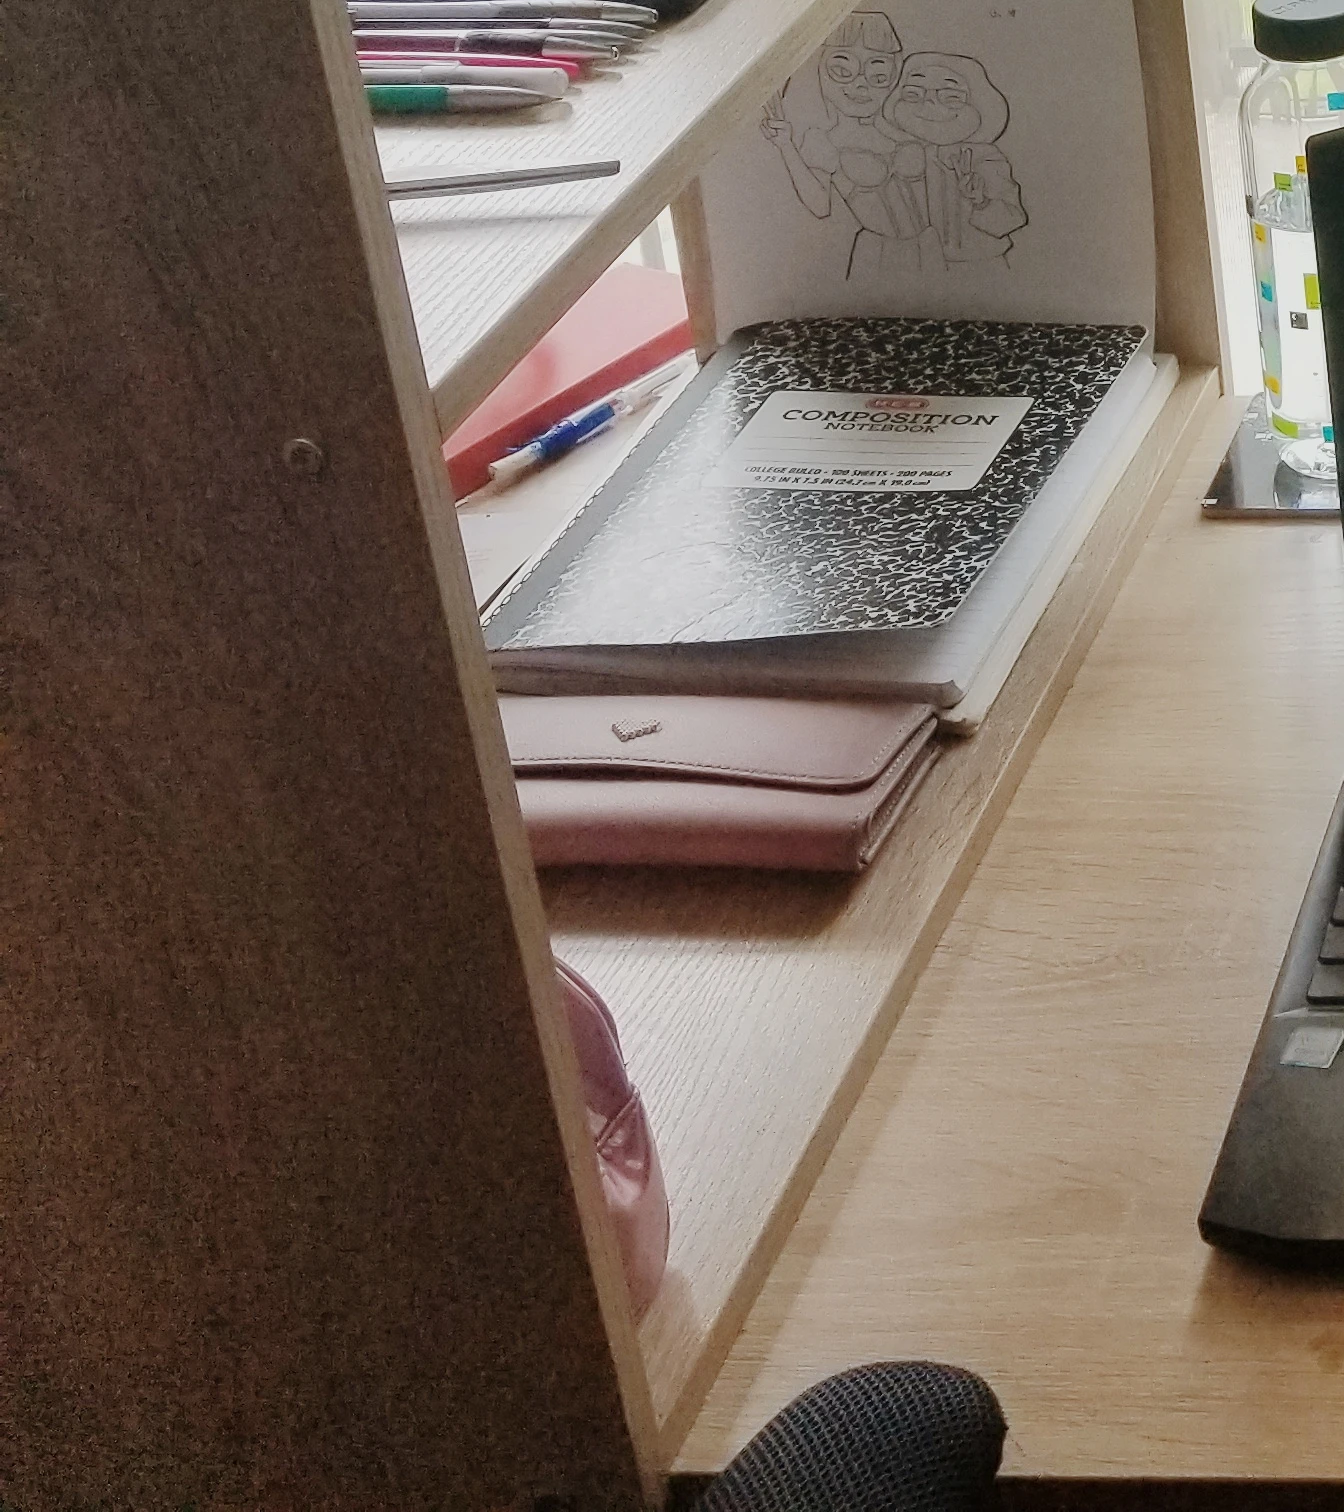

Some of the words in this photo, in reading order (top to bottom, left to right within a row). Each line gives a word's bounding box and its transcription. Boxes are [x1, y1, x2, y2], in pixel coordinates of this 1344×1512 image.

[782, 409, 999, 426] COMPOSITION
[823, 422, 939, 434] NOTEBOOK
[745, 466, 788, 474] COLLEGE
[788, 467, 822, 475] RULED
[851, 469, 888, 477] SHEETS
